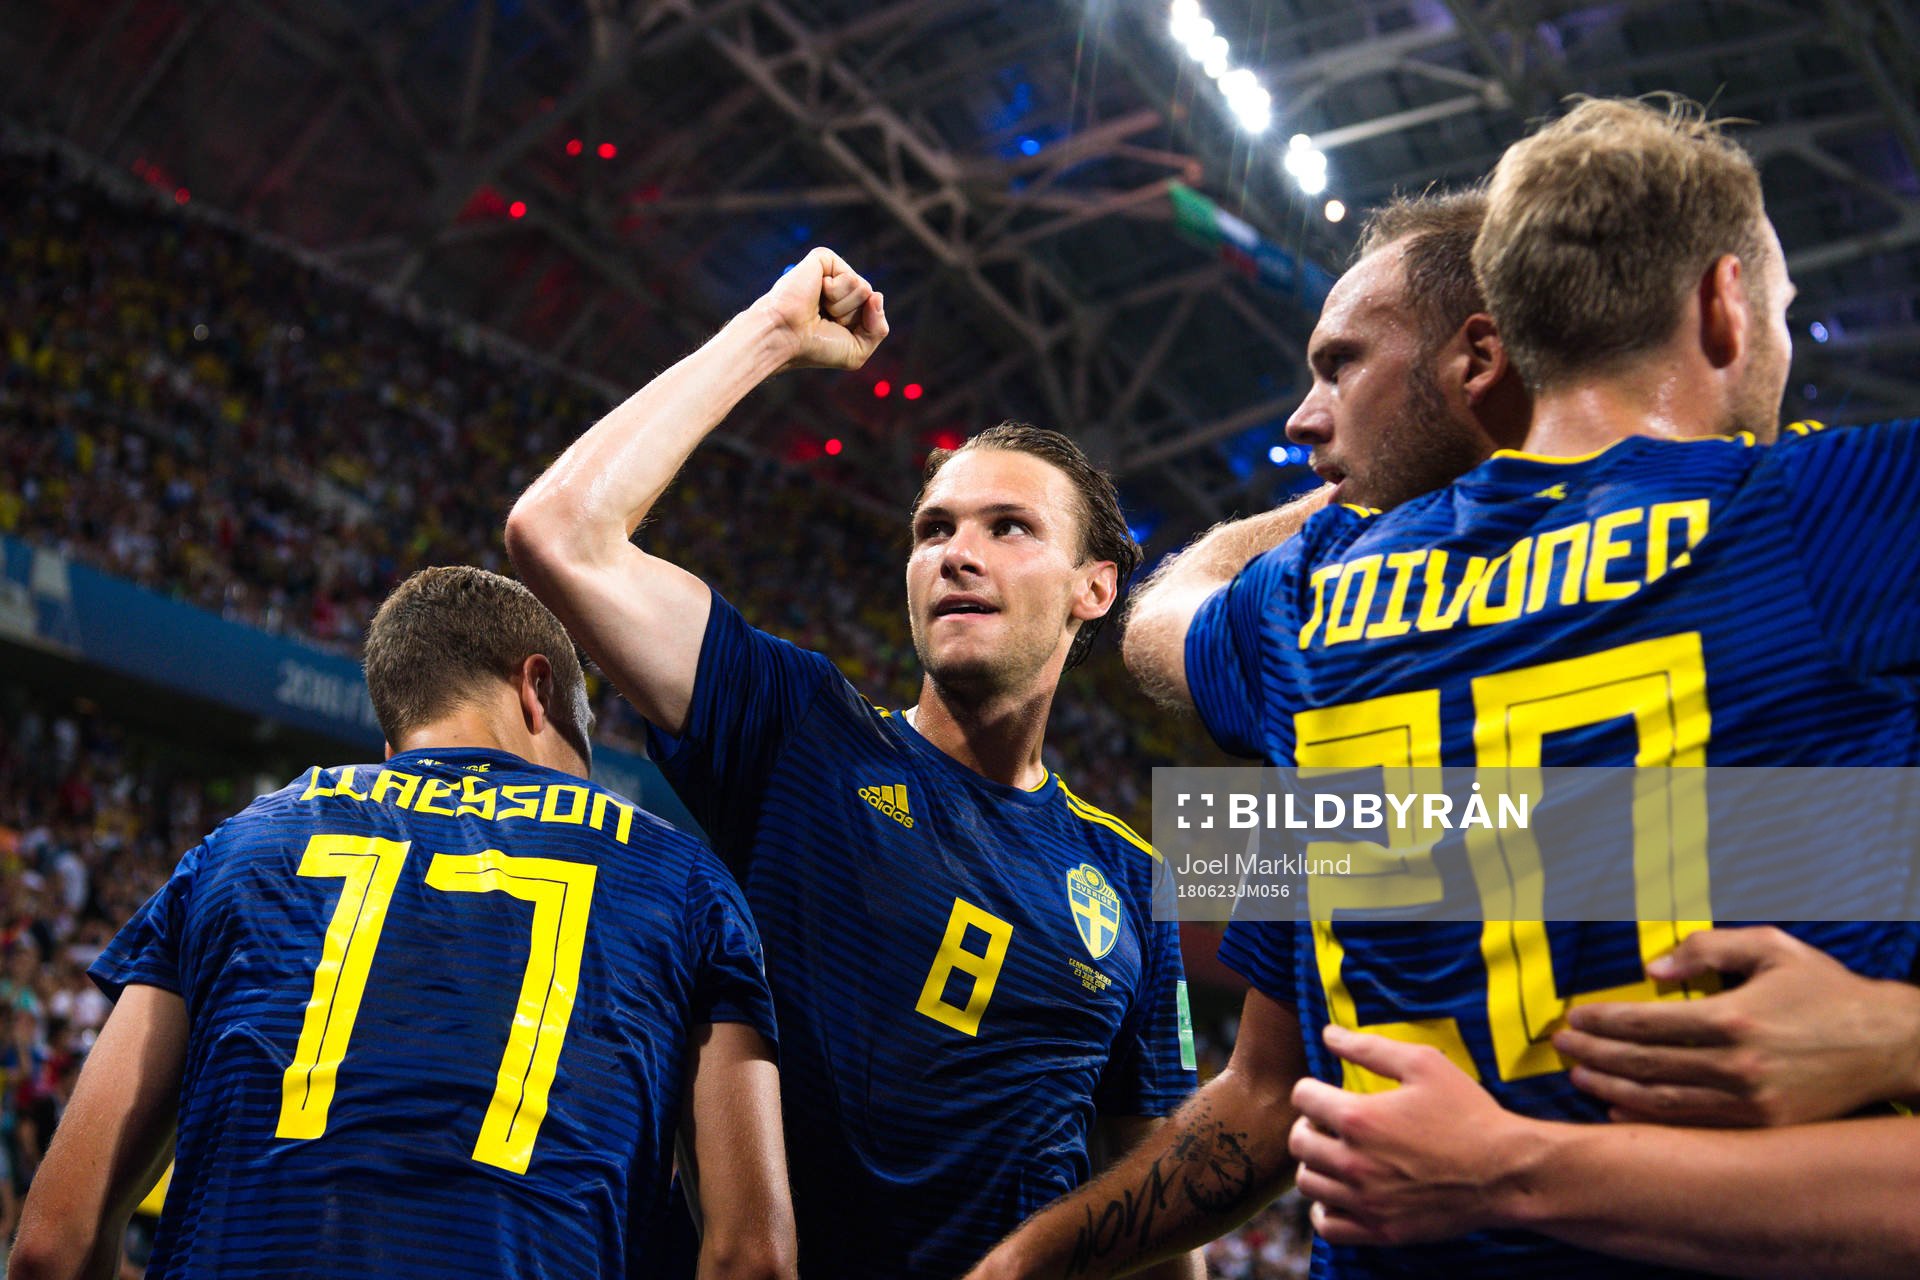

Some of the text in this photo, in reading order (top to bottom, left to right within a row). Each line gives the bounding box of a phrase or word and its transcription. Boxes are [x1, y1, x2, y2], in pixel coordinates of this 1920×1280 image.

[1298, 498, 1710, 651] TOIVONEN
[857, 787, 915, 829] adidas
[1293, 631, 1722, 1094] 20
[1075, 882, 1113, 907] SVERIGE
[914, 896, 1014, 1037] 8
